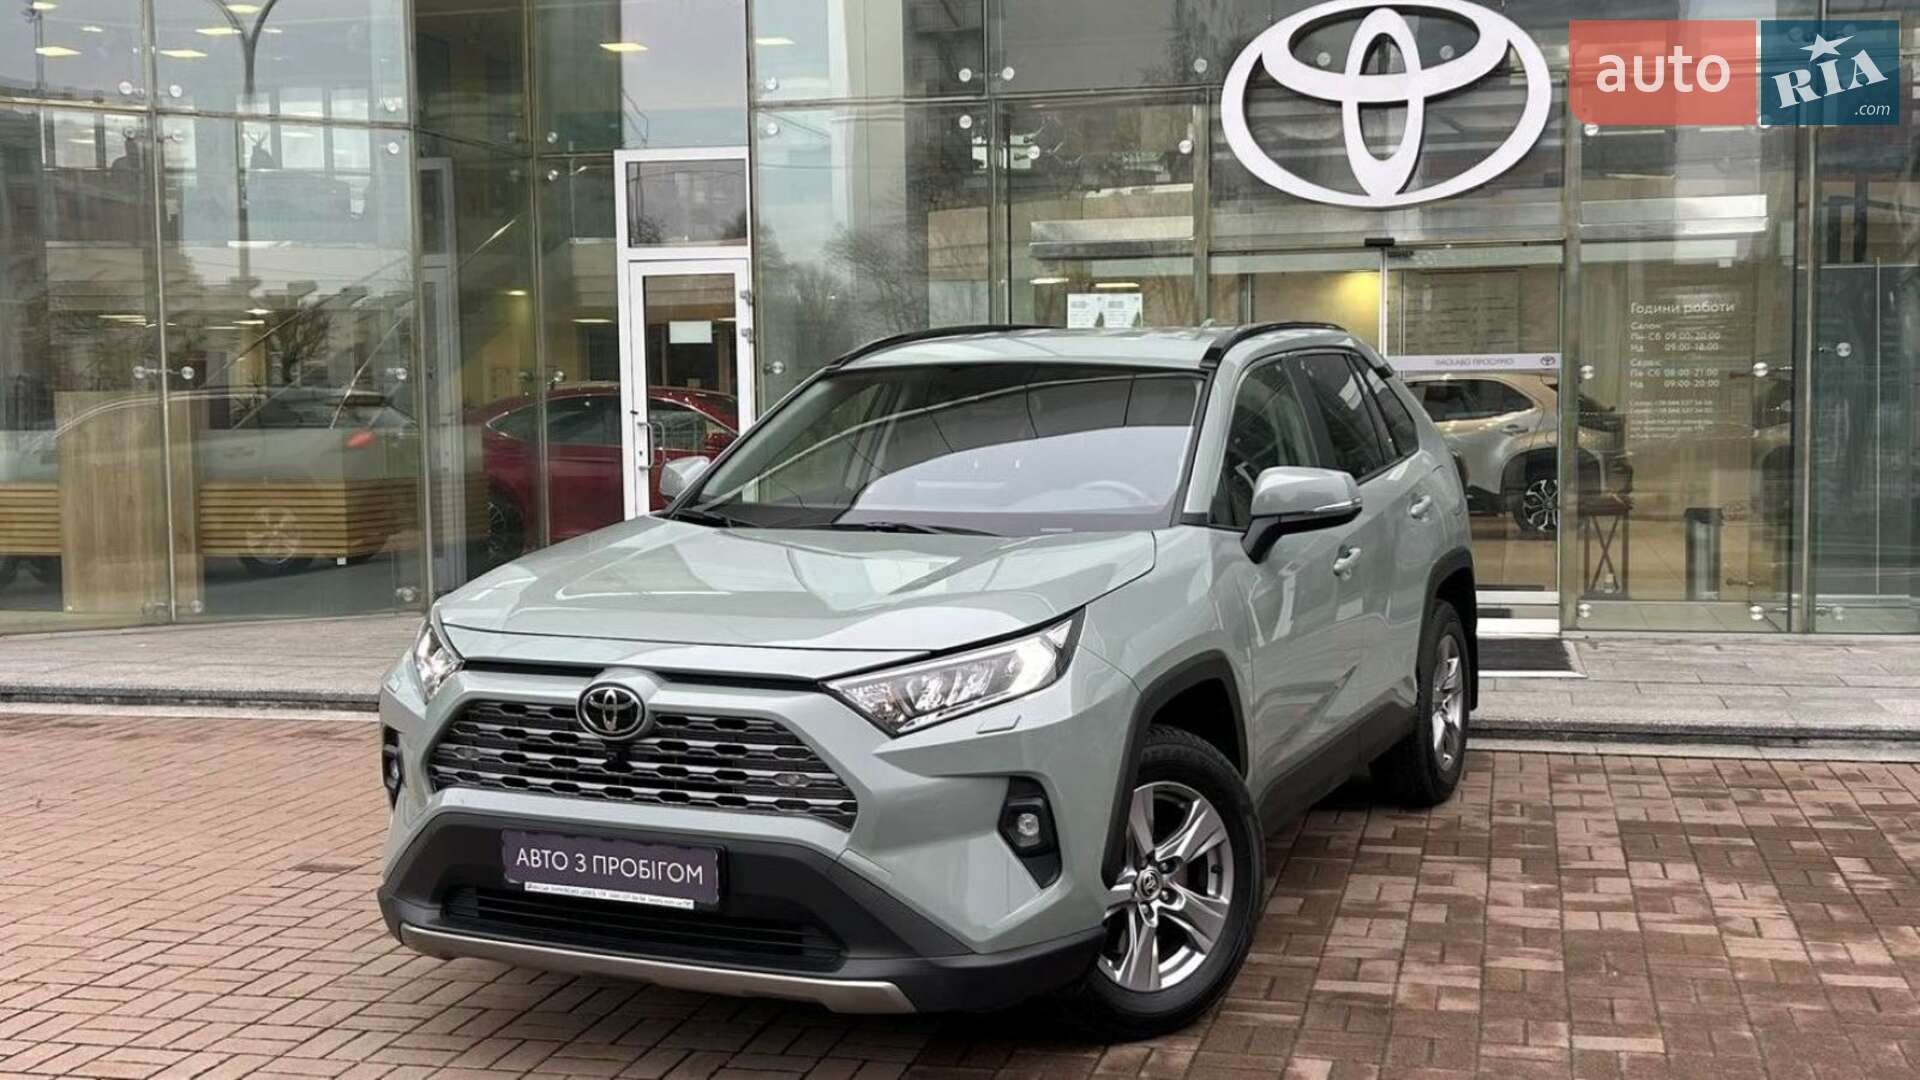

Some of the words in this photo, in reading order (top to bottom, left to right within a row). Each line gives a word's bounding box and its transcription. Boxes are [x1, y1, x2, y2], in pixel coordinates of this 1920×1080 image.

[1630, 302, 1681, 315] Години
[1683, 300, 1736, 315] роботи
[515, 847, 569, 871] АВТО
[574, 853, 588, 873] З
[592, 855, 704, 885] ПРОБІГОМ
